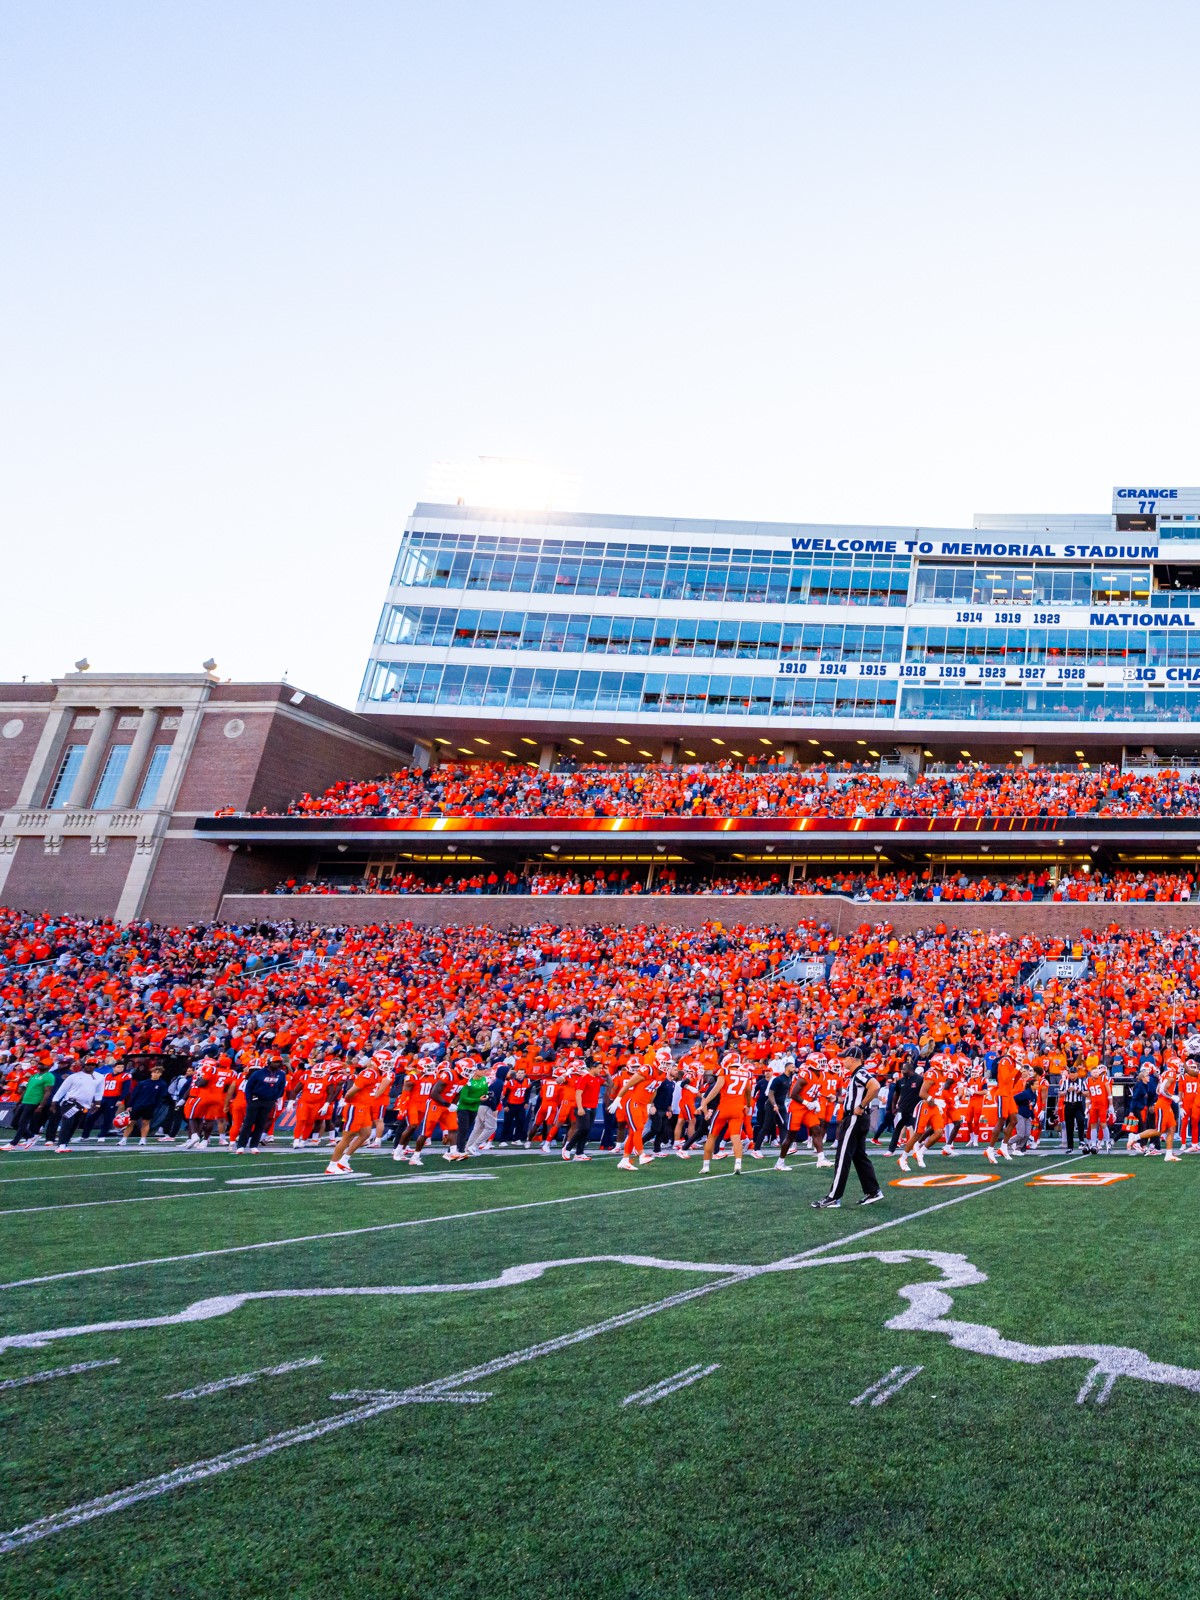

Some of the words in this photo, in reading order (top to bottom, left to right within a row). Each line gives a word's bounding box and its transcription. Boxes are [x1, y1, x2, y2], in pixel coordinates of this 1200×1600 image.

[1117, 489, 1178, 499] GRANGE
[1138, 501, 1156, 514] 77
[792, 538, 897, 553] WELCOME
[905, 540, 933, 554] TO
[941, 542, 1056, 557] MEMORIAL
[1064, 545, 1159, 559] STADIUM
[956, 612, 982, 623] 1914
[995, 612, 1021, 624] 1919
[1033, 613, 1060, 624] 1923
[1089, 613, 1195, 627] NATIONAL
[779, 662, 806, 674] 1910
[819, 663, 847, 675] 1914
[859, 664, 886, 676] 1915
[900, 665, 926, 676] 1918
[939, 666, 966, 677] 1919
[978, 666, 1006, 678] 1923
[1018, 667, 1045, 679] 1927
[1058, 668, 1085, 680] 1928
[308, 1083, 322, 1094] 92
[420, 1083, 432, 1095] 10
[727, 1076, 748, 1095] 27
[981, 1132, 989, 1140] G
